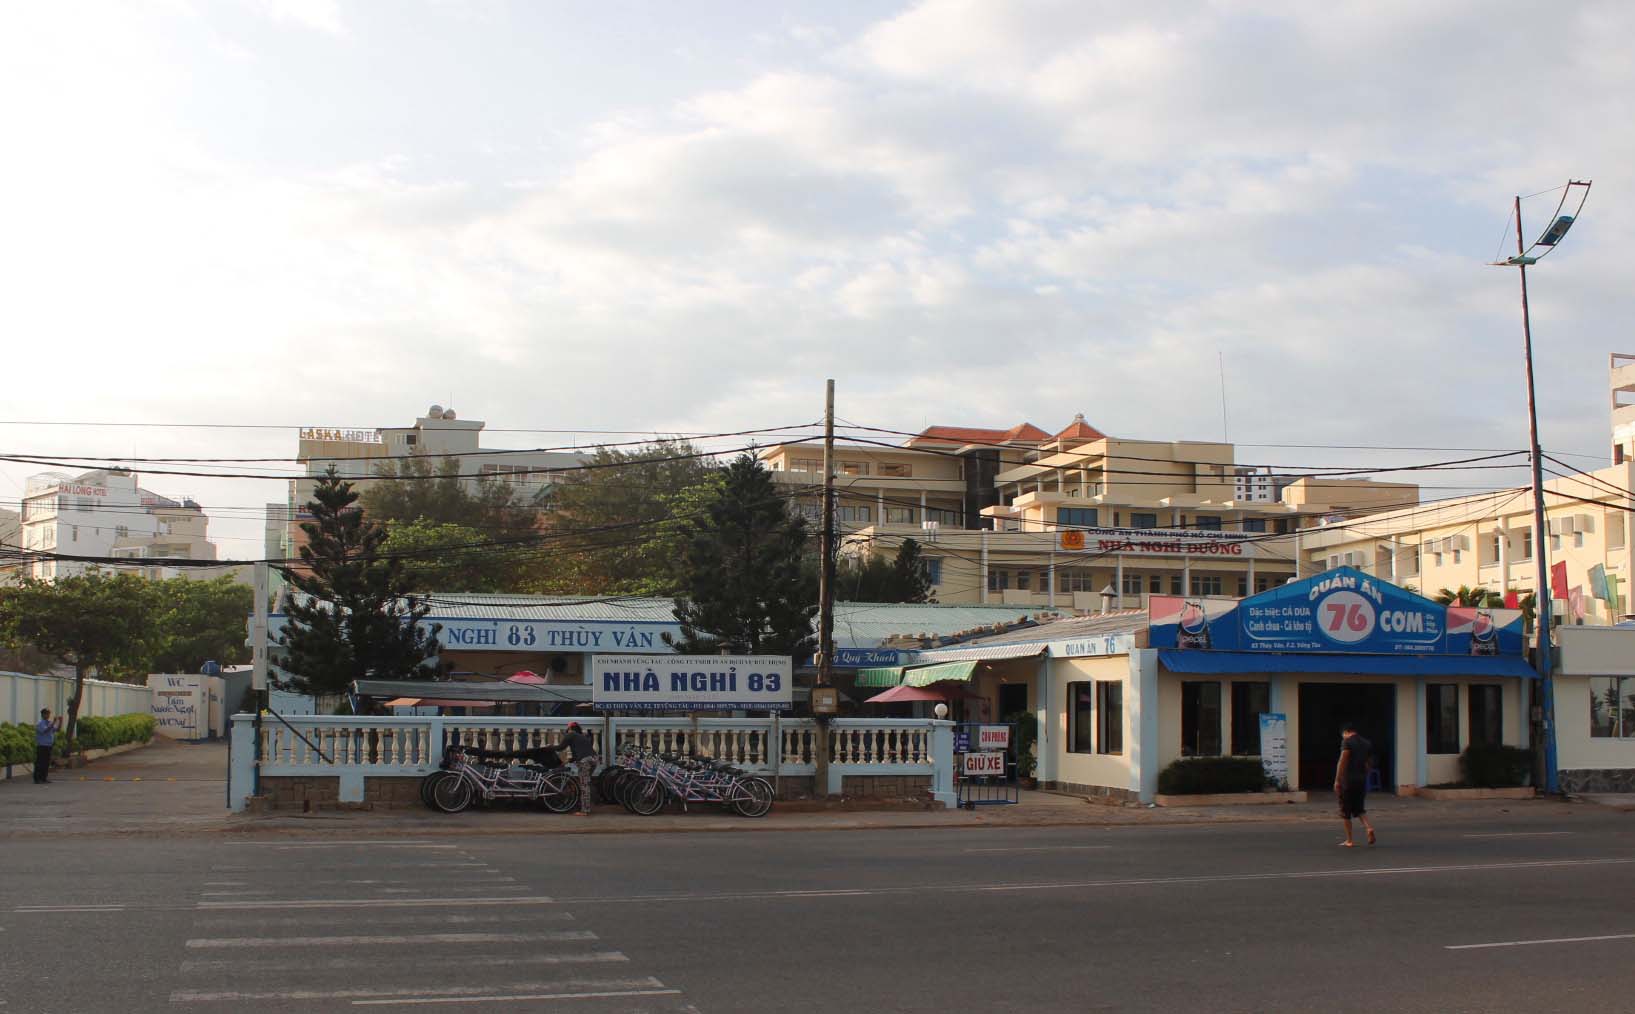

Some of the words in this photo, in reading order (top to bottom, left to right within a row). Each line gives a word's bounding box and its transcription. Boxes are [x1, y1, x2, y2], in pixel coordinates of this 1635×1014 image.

[59, 484, 71, 493] HAI
[73, 486, 91, 495] LONG
[1098, 537, 1135, 551] NHÀ
[1326, 603, 1368, 632] 76
[508, 625, 536, 646] 83
[548, 626, 602, 647] THÙY
[612, 626, 654, 648] VÂN
[1104, 635, 1116, 654] 76
[167, 677, 185, 687] WC
[603, 667, 660, 691] NHÀ
[671, 666, 736, 692] NGHỈ
[748, 673, 781, 692] 83
[987, 757, 1001, 770] XE
